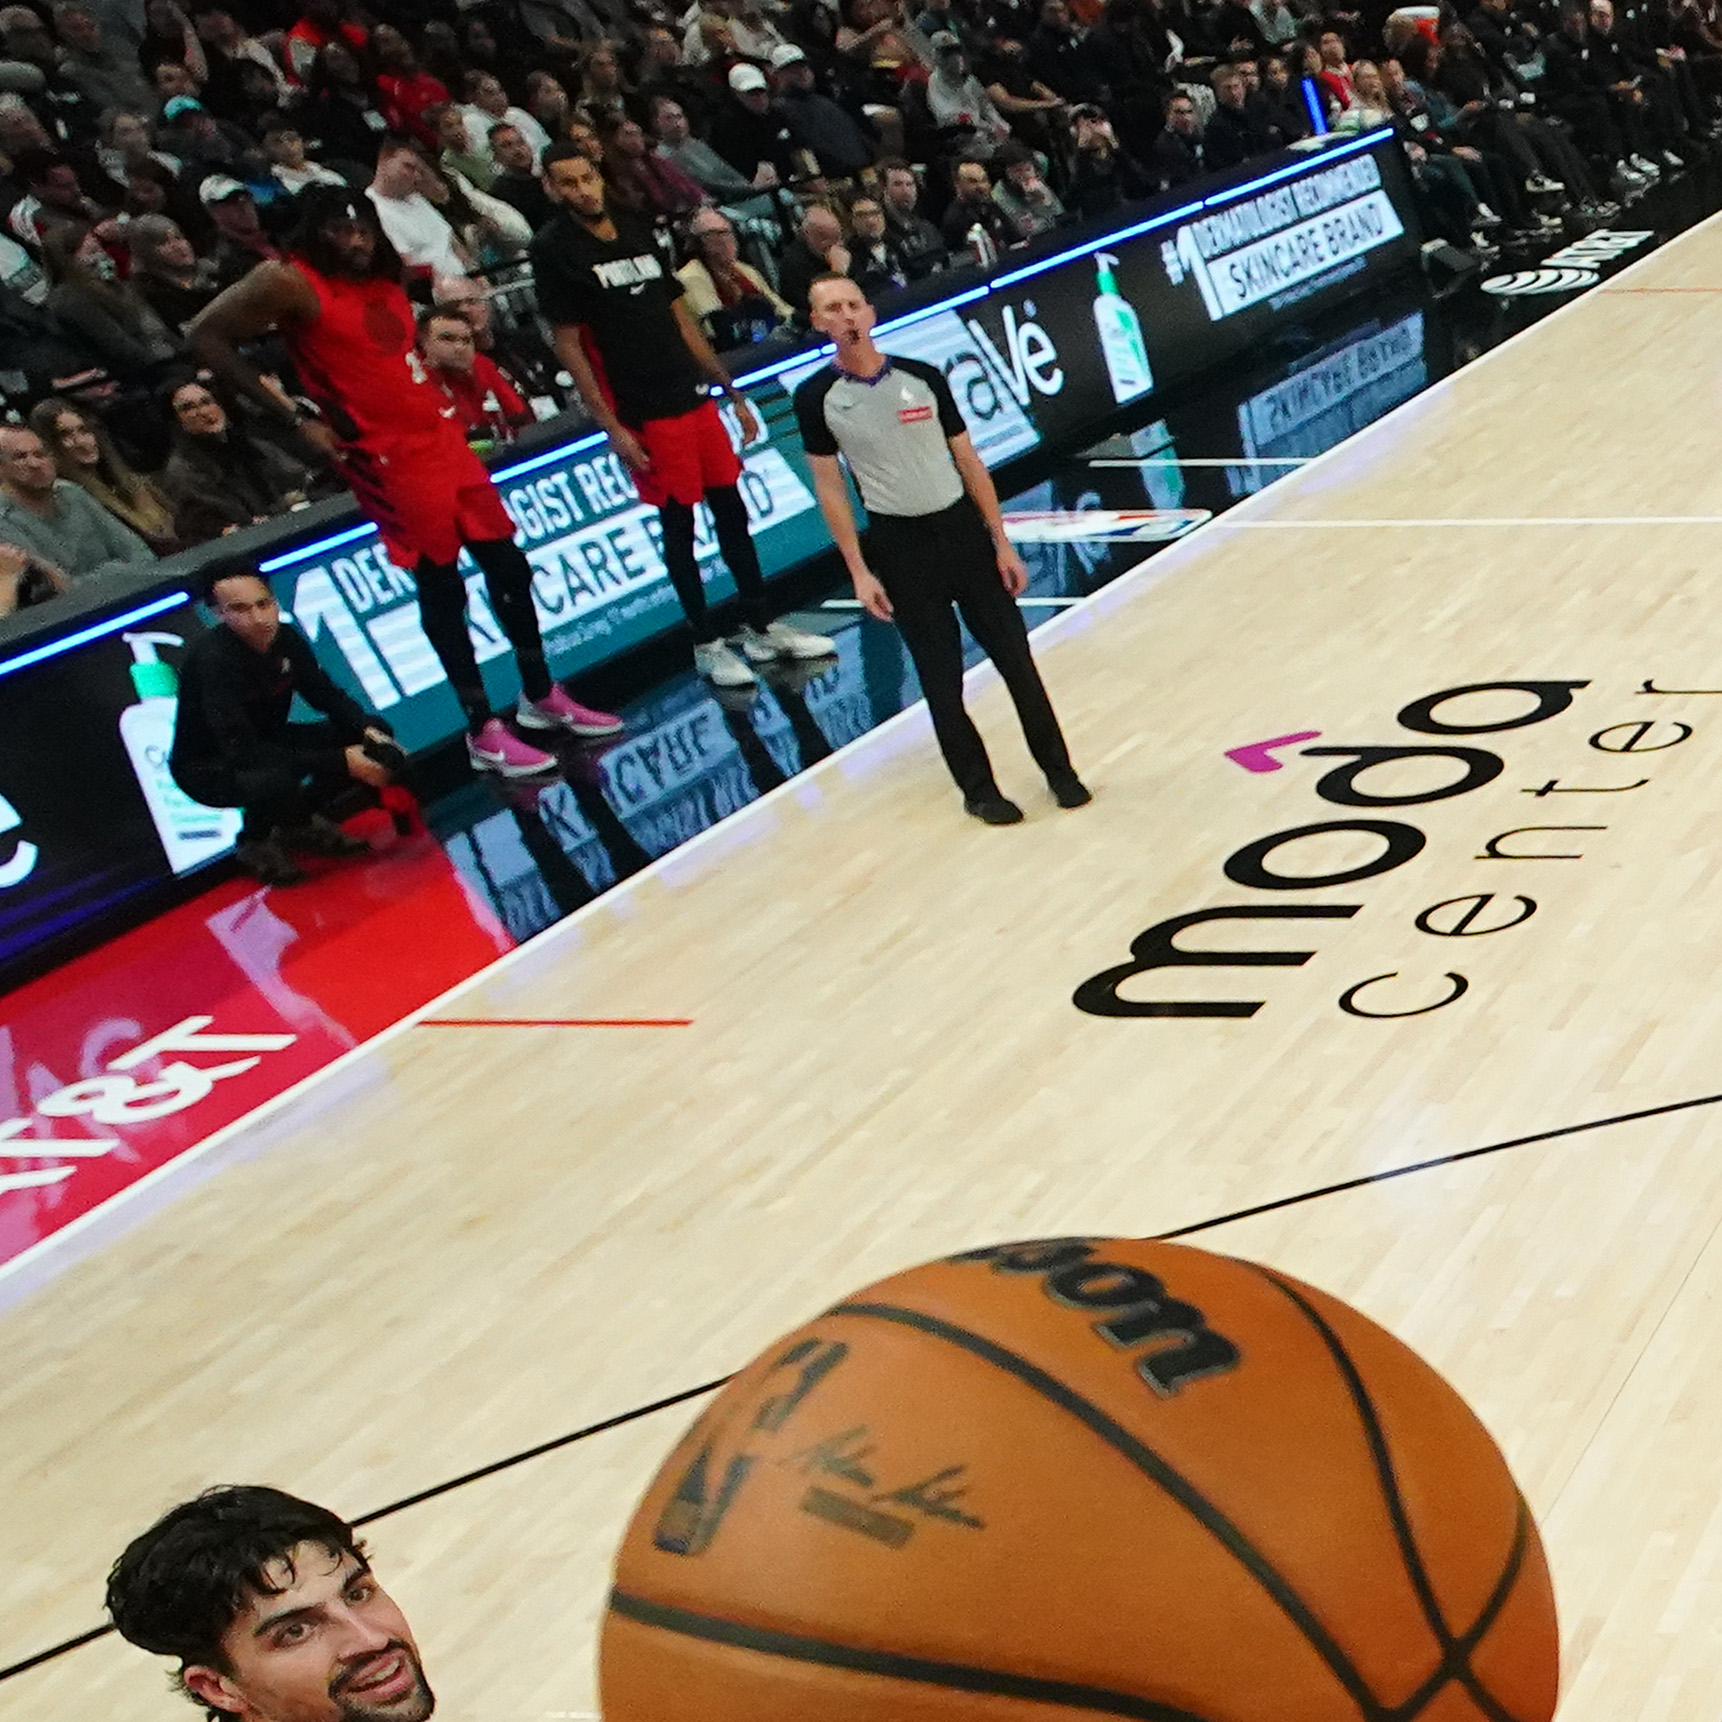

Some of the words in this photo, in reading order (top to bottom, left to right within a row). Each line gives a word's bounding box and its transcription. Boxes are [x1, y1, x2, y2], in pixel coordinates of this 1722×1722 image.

[1228, 227, 1325, 300] SKINCARE
[1322, 202, 1383, 257] BRAND
[1071, 679, 1593, 1019] moda
